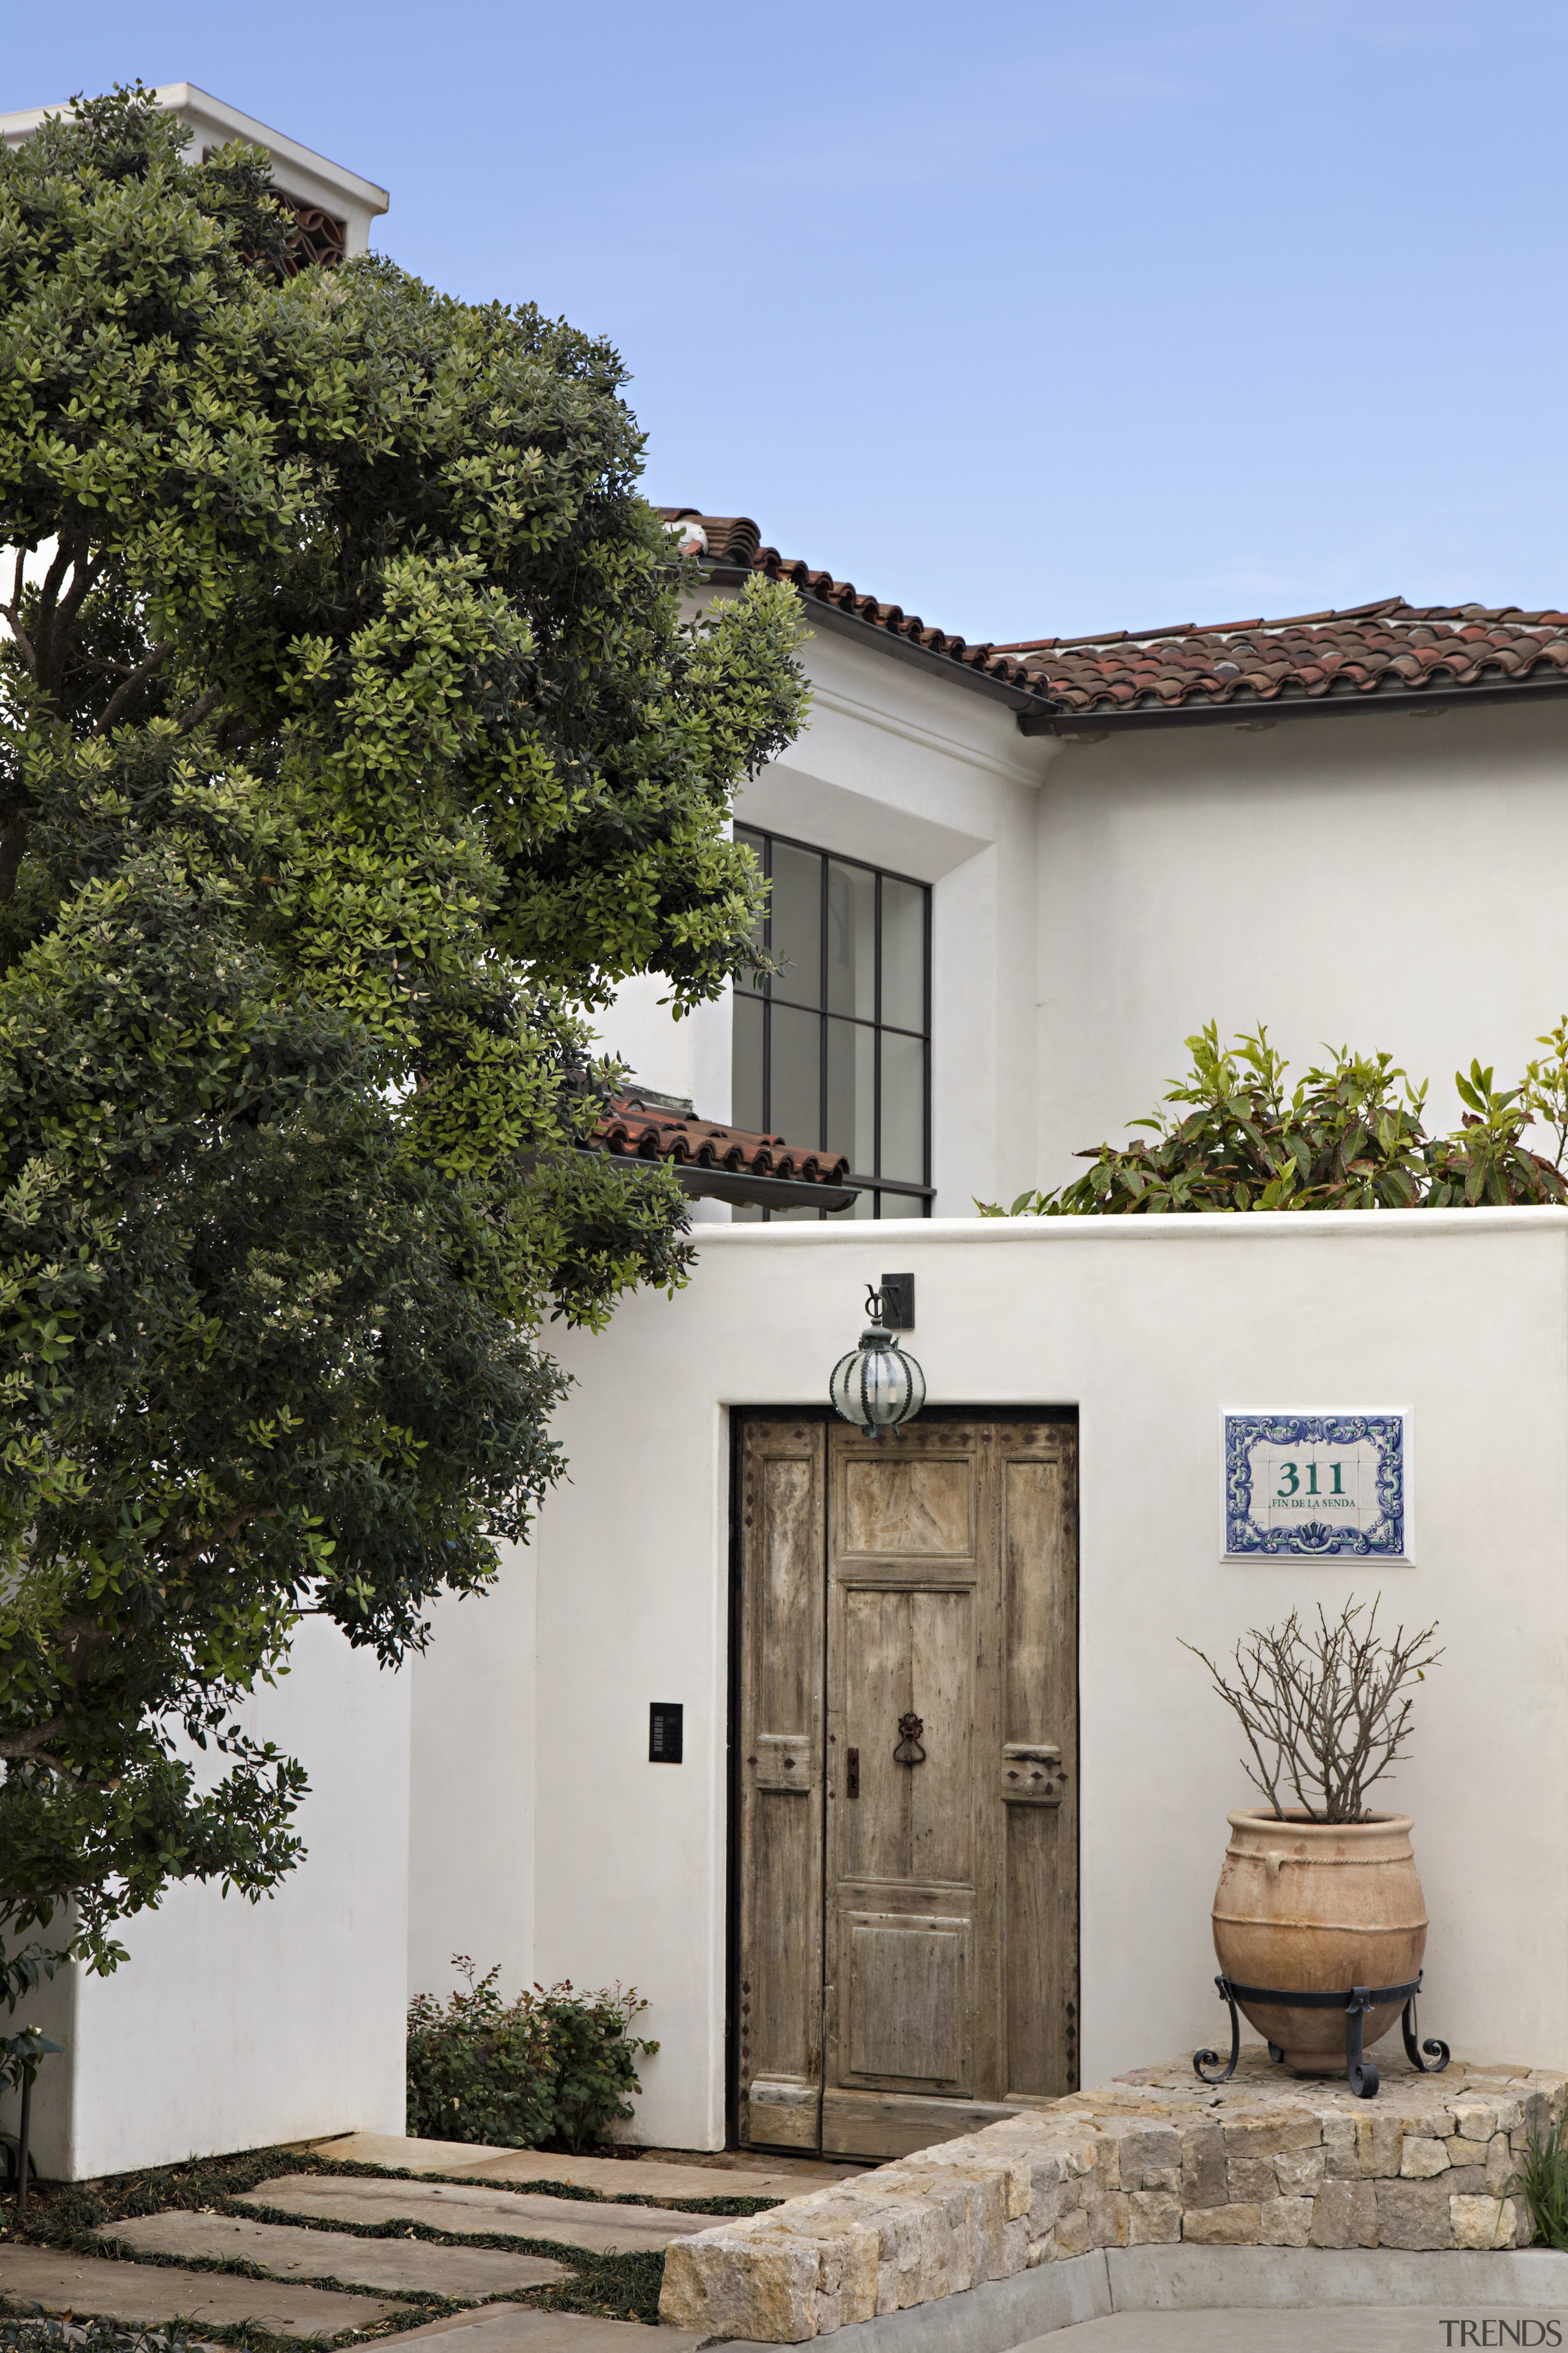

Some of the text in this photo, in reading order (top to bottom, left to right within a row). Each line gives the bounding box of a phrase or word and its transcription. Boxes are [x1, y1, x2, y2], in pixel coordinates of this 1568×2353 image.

[1277, 1462, 1346, 1497] 311
[1272, 1498, 1355, 1508] FIN DE LA SENDA
